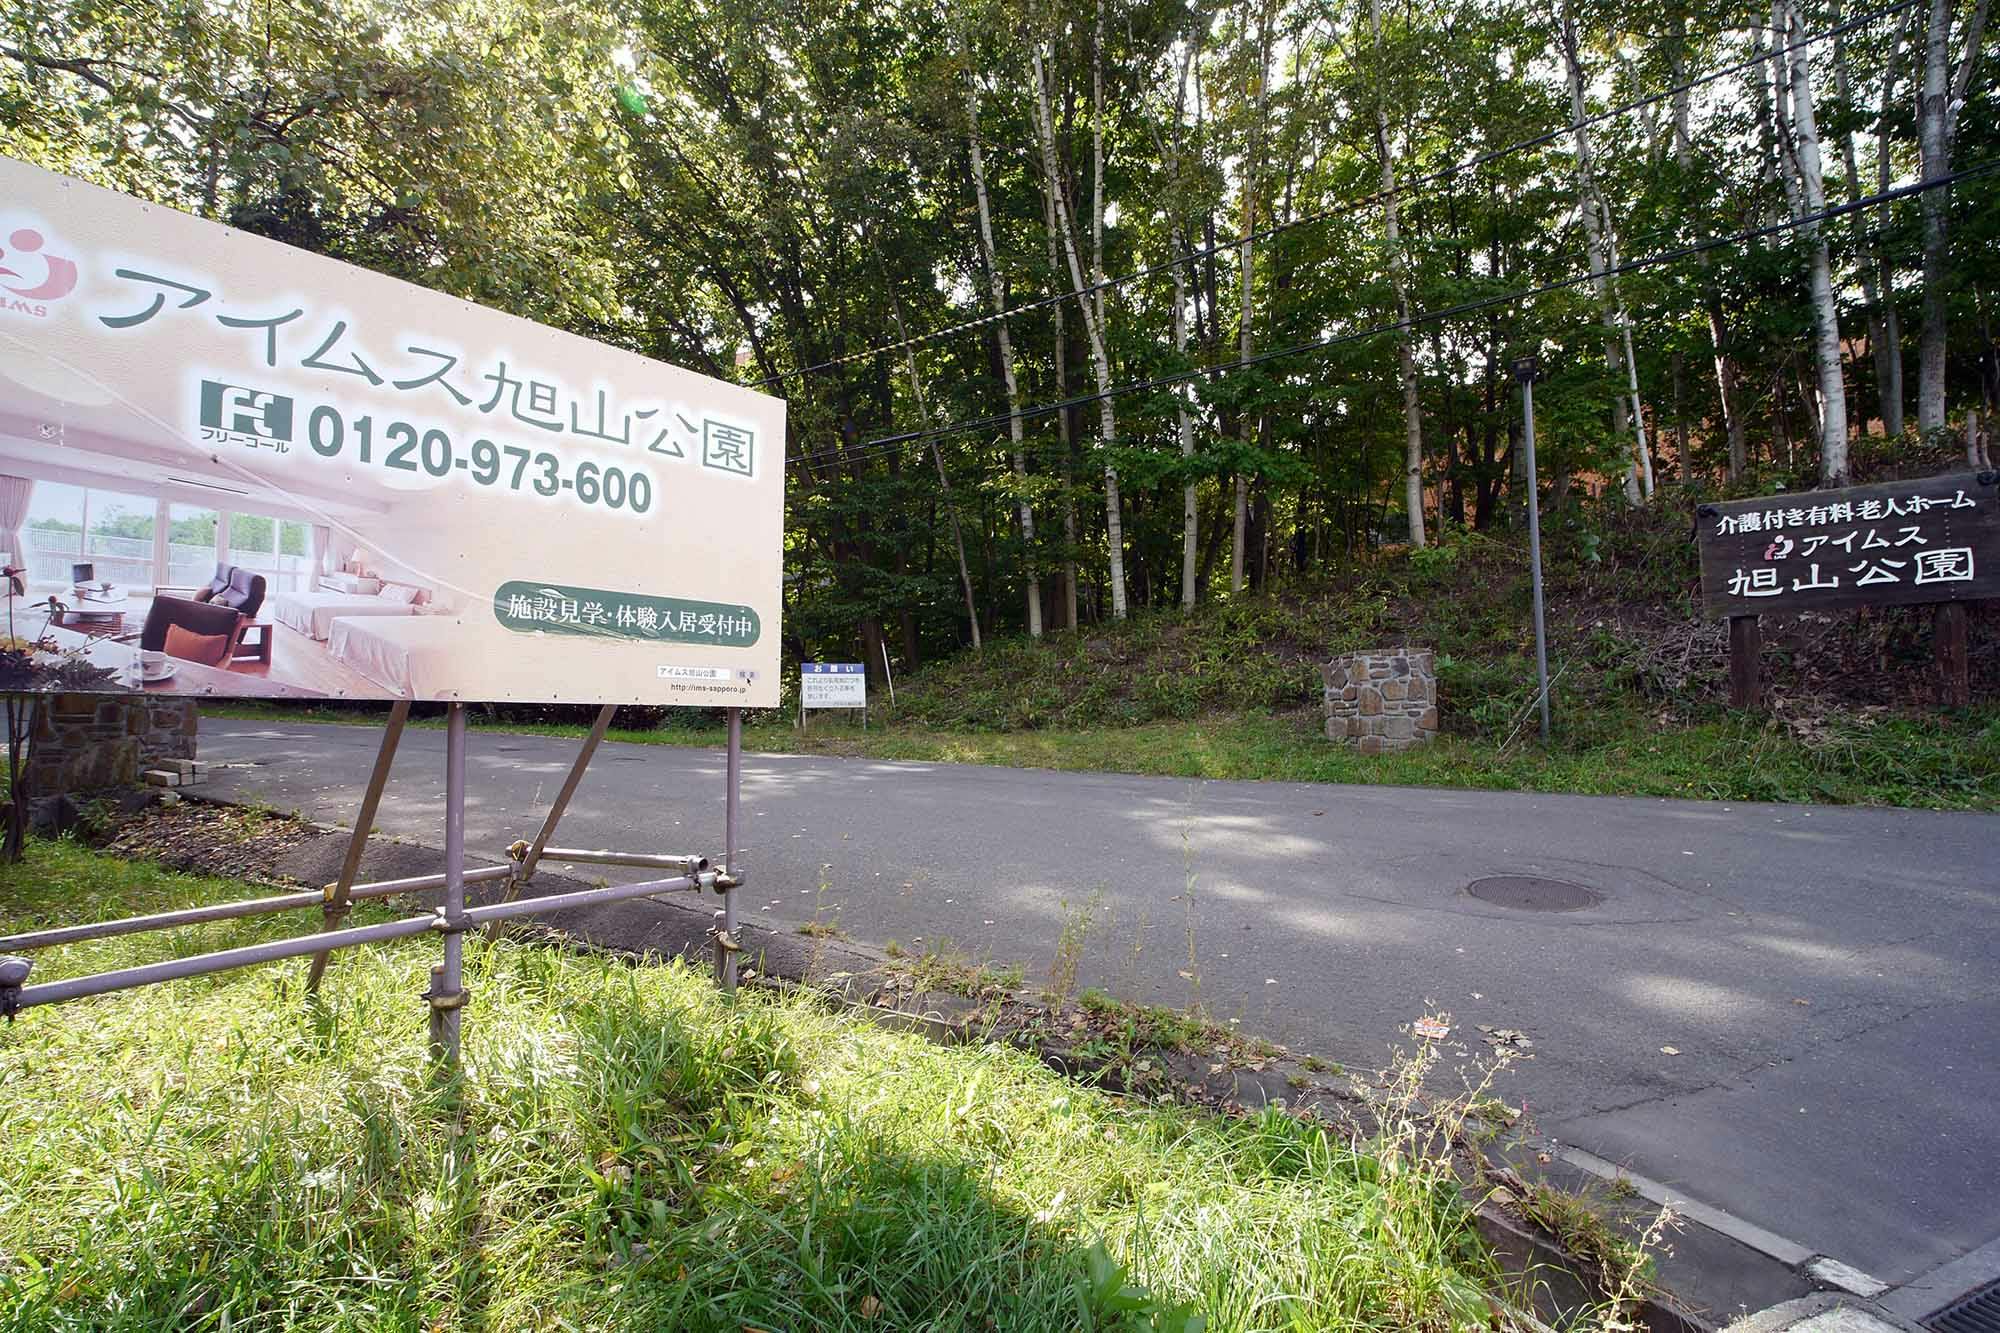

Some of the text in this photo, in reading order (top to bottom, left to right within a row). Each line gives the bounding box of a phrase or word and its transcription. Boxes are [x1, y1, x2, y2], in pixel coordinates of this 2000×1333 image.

[99, 268, 755, 477] アイムス旭山公園
[200, 428, 290, 454] フリーコール
[308, 405, 652, 513] 0120-973-600
[1716, 490, 1976, 536] 介護付き有料老人ホーム
[1801, 526, 1928, 557] アイムス
[1727, 547, 1974, 597] 旭山公園
